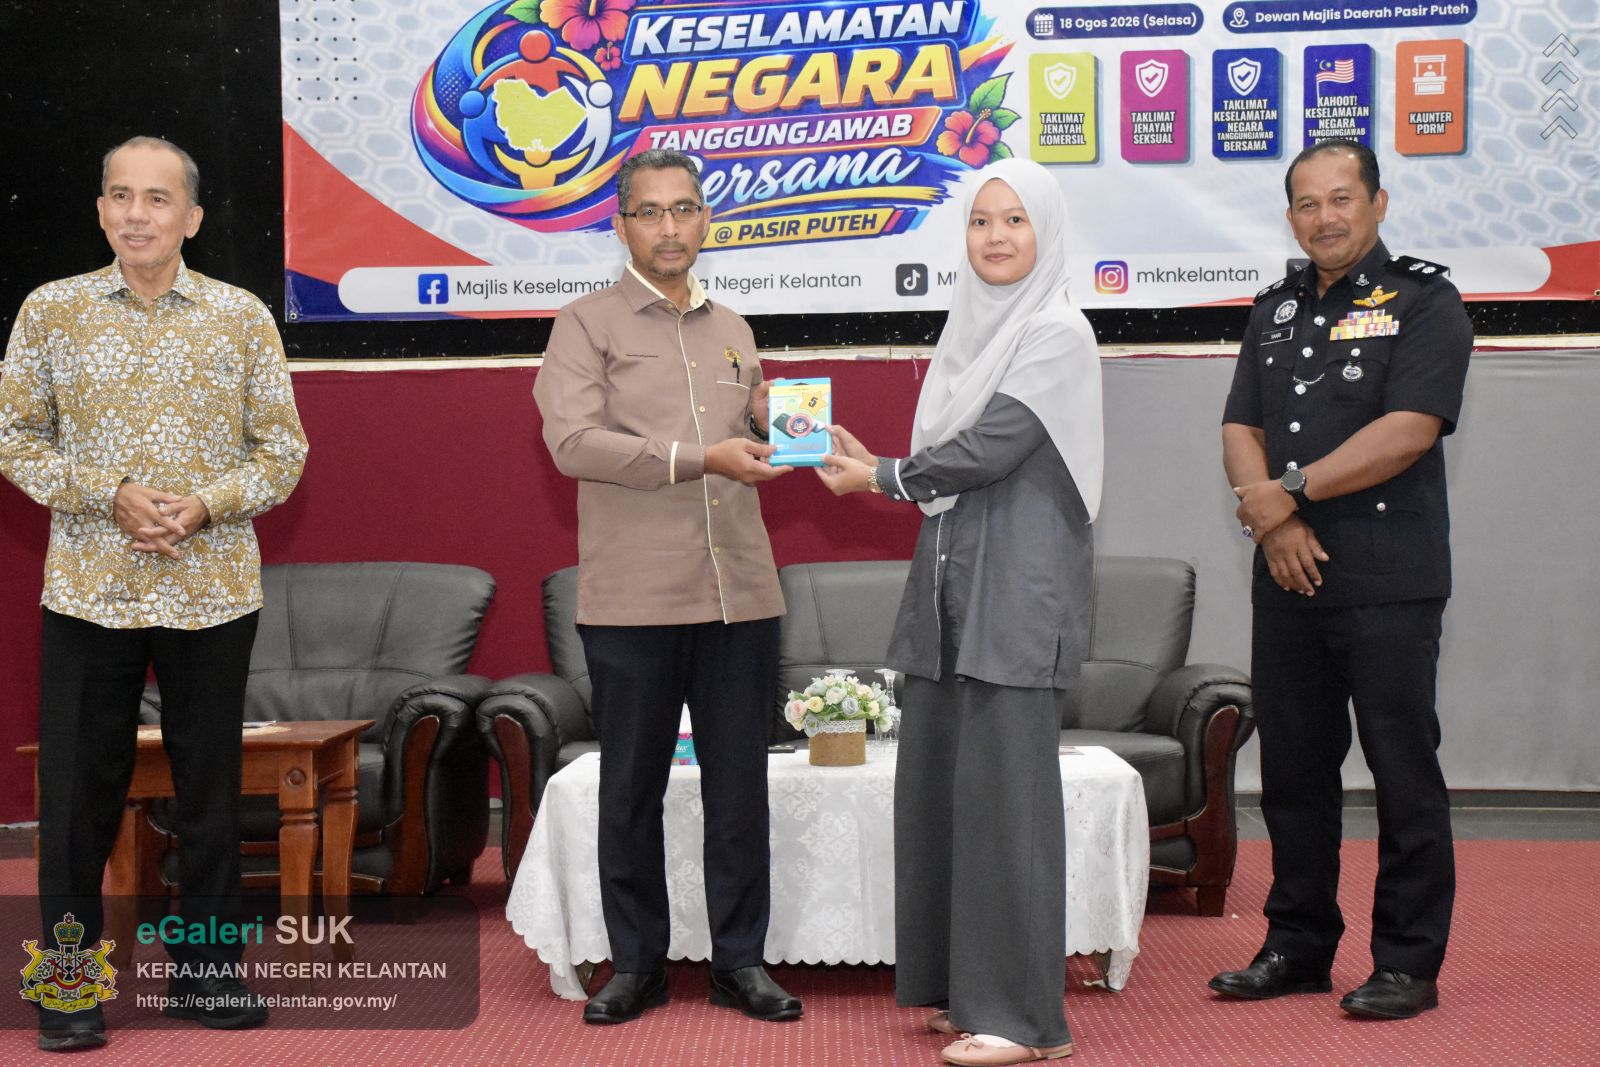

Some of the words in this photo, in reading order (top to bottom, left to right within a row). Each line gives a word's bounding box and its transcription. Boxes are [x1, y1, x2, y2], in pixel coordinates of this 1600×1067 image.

[1255, 12, 1300, 23] Dewan
[1302, 10, 1341, 23] Majlis
[1343, 7, 1392, 19] Daerah
[1395, 6, 1428, 17] Pasir
[1430, 3, 1469, 15] Puteh
[1060, 18, 1072, 29] 18
[1075, 17, 1108, 31] Ogos
[1110, 16, 1140, 27] 2026
[1143, 12, 1197, 29] (Selasa)
[630, 1, 964, 56] KESELAMATAN
[618, 44, 958, 120] NEGARA
[1223, 99, 1268, 110] TAKLIMAT
[1317, 95, 1358, 107] KAHOOT!
[1131, 111, 1176, 122] TAKLIMAT
[1214, 110, 1277, 121] KESELAMATAN
[1305, 106, 1370, 118] KESELAMATAN
[1040, 113, 1085, 124] TAKLIMAT
[1318, 118, 1356, 129] NEGARA
[1409, 112, 1452, 124] KAUNTER
[649, 113, 913, 151] TANGGUNGJAWAB
[1042, 124, 1082, 134] JENAYAH
[1133, 122, 1173, 133] JENAYAH
[1227, 121, 1264, 132] NEGARA
[1308, 127, 1366, 137] TANGGUNGJAWAB
[1416, 123, 1445, 134] PDRM
[1040, 134, 1086, 145] KOMERSIL
[1133, 133, 1174, 144] SEKSUAL
[1217, 131, 1274, 140] TANGGUNGJAWAB
[1223, 140, 1267, 151] BERSAMA
[686, 147, 922, 208] ersama
[715, 226, 733, 243] @
[738, 219, 800, 241] PASIR
[806, 213, 878, 234] PUTEH
[1137, 267, 1259, 283] mknkelantan
[456, 279, 508, 300] Majlis
[513, 278, 620, 295] Keselamat
[715, 274, 774, 295] Negeri
[779, 273, 862, 290] Kelantan
